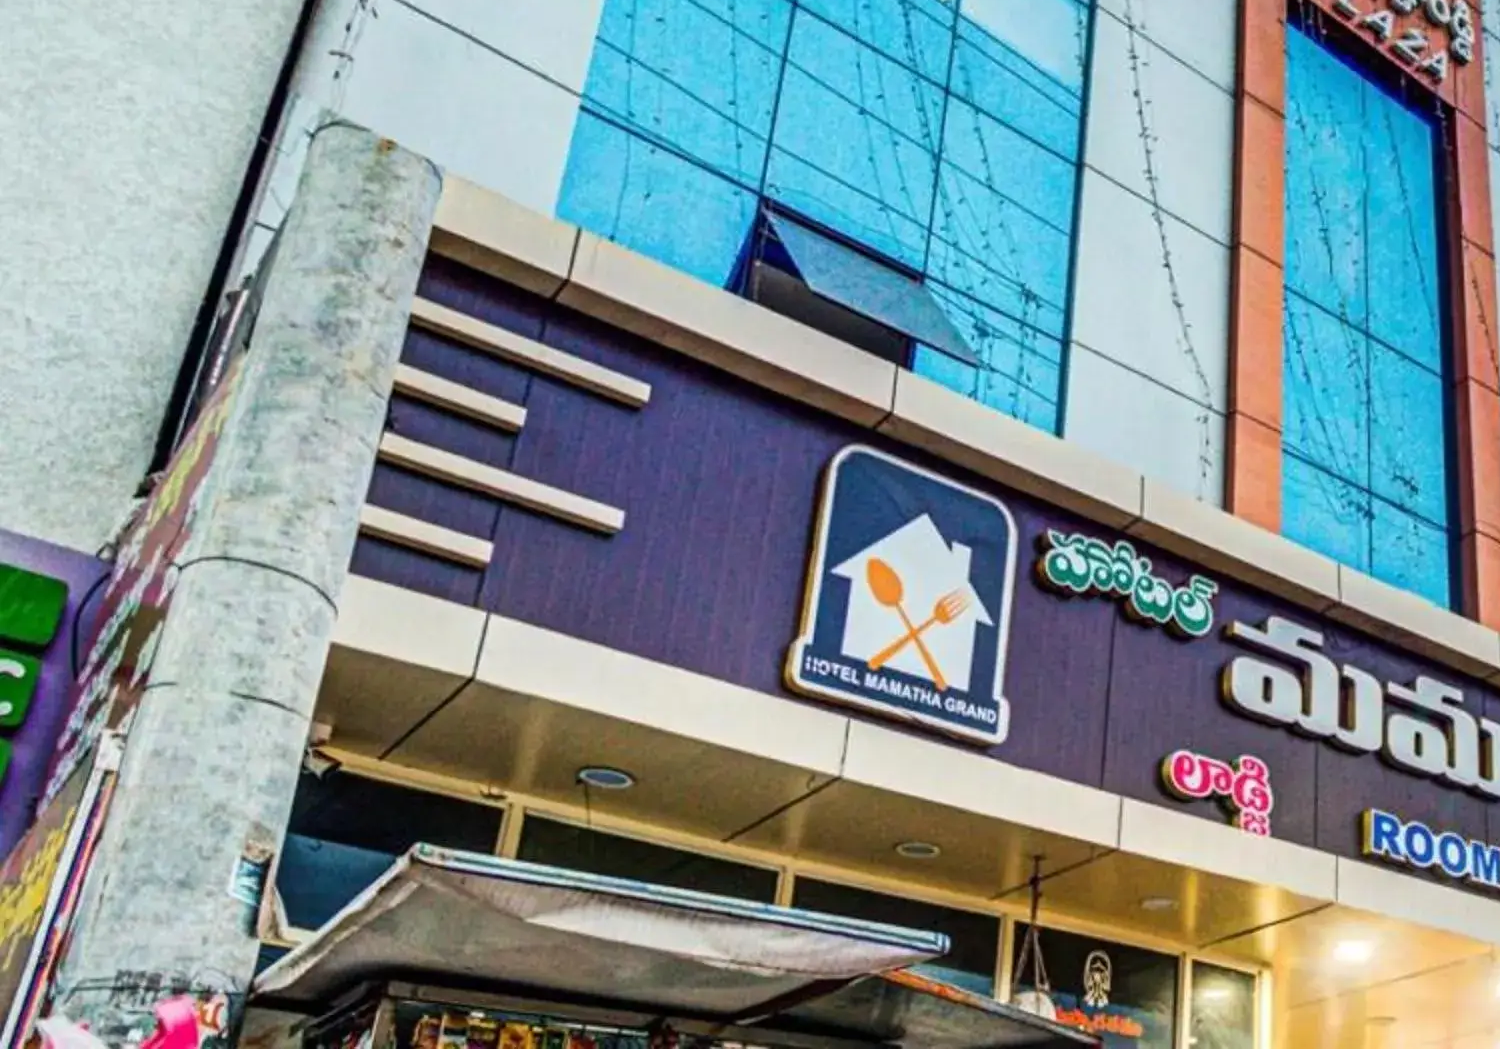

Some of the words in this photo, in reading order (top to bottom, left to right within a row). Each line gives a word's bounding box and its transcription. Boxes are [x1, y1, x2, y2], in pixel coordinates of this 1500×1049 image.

[1045, 527, 1220, 637] హోటల్
[804, 655, 861, 687] HOTEL
[863, 671, 942, 709] MAMATHA
[944, 695, 997, 723] GRAND
